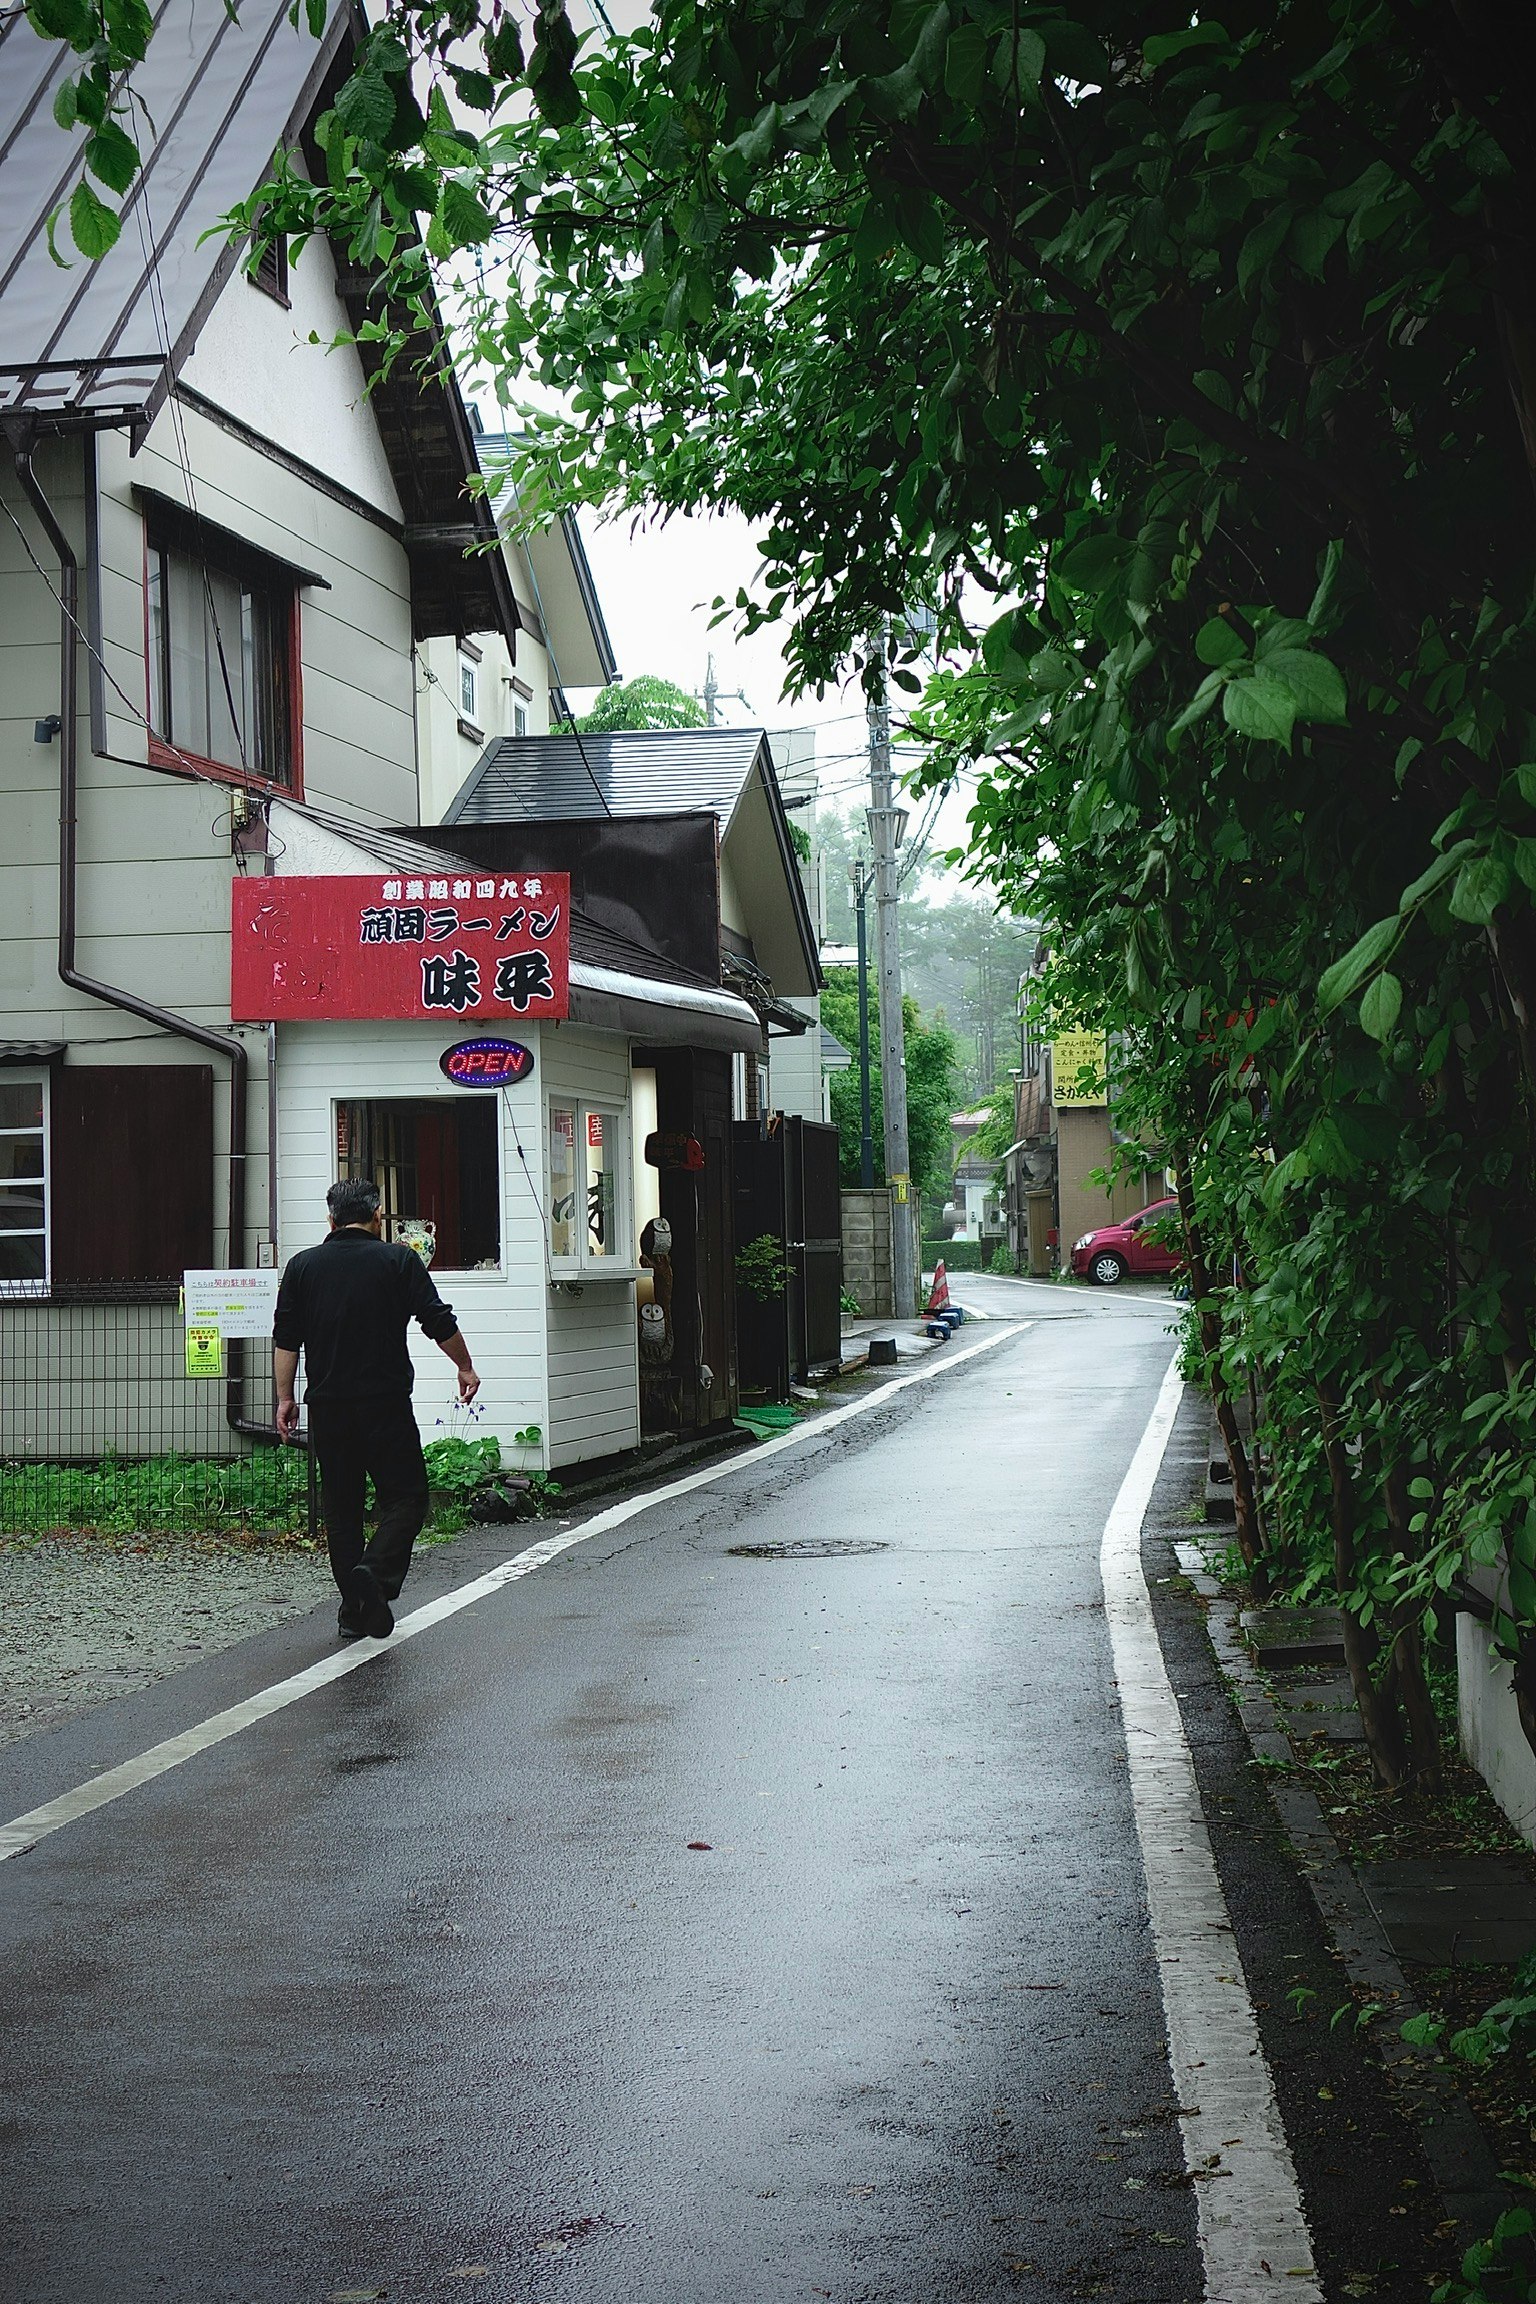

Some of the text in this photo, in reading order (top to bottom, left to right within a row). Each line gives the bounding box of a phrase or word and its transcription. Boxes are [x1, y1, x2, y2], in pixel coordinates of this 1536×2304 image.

[382, 878, 543, 900] 創業昭和四九年
[360, 903, 561, 945] 頑固ラーメン
[420, 949, 554, 1012] 味平
[447, 1052, 526, 1075] OPEN
